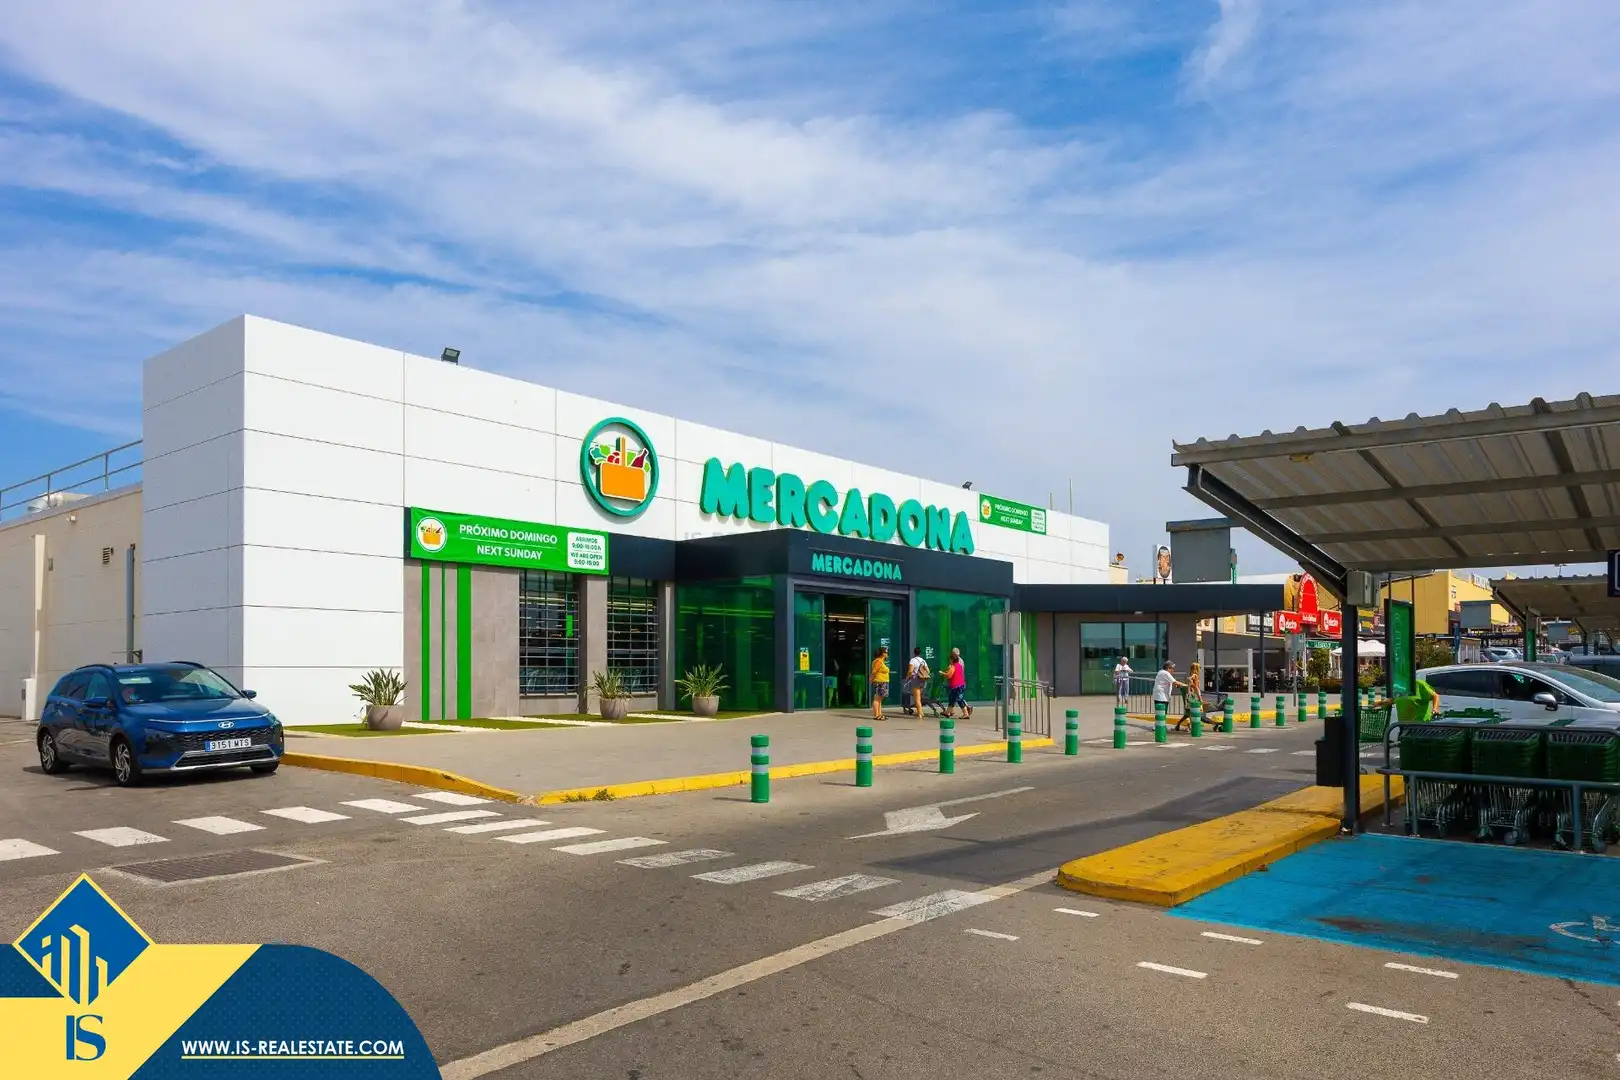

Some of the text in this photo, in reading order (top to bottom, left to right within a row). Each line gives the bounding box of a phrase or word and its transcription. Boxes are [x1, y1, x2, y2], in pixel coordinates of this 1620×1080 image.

[700, 457, 975, 555] MERCADONA
[459, 523, 558, 544] PRÓXIMO DOMINGO
[477, 545, 543, 559] NEXT SUNDAY
[812, 553, 902, 581] MERCADONA
[211, 741, 232, 750] 3151
